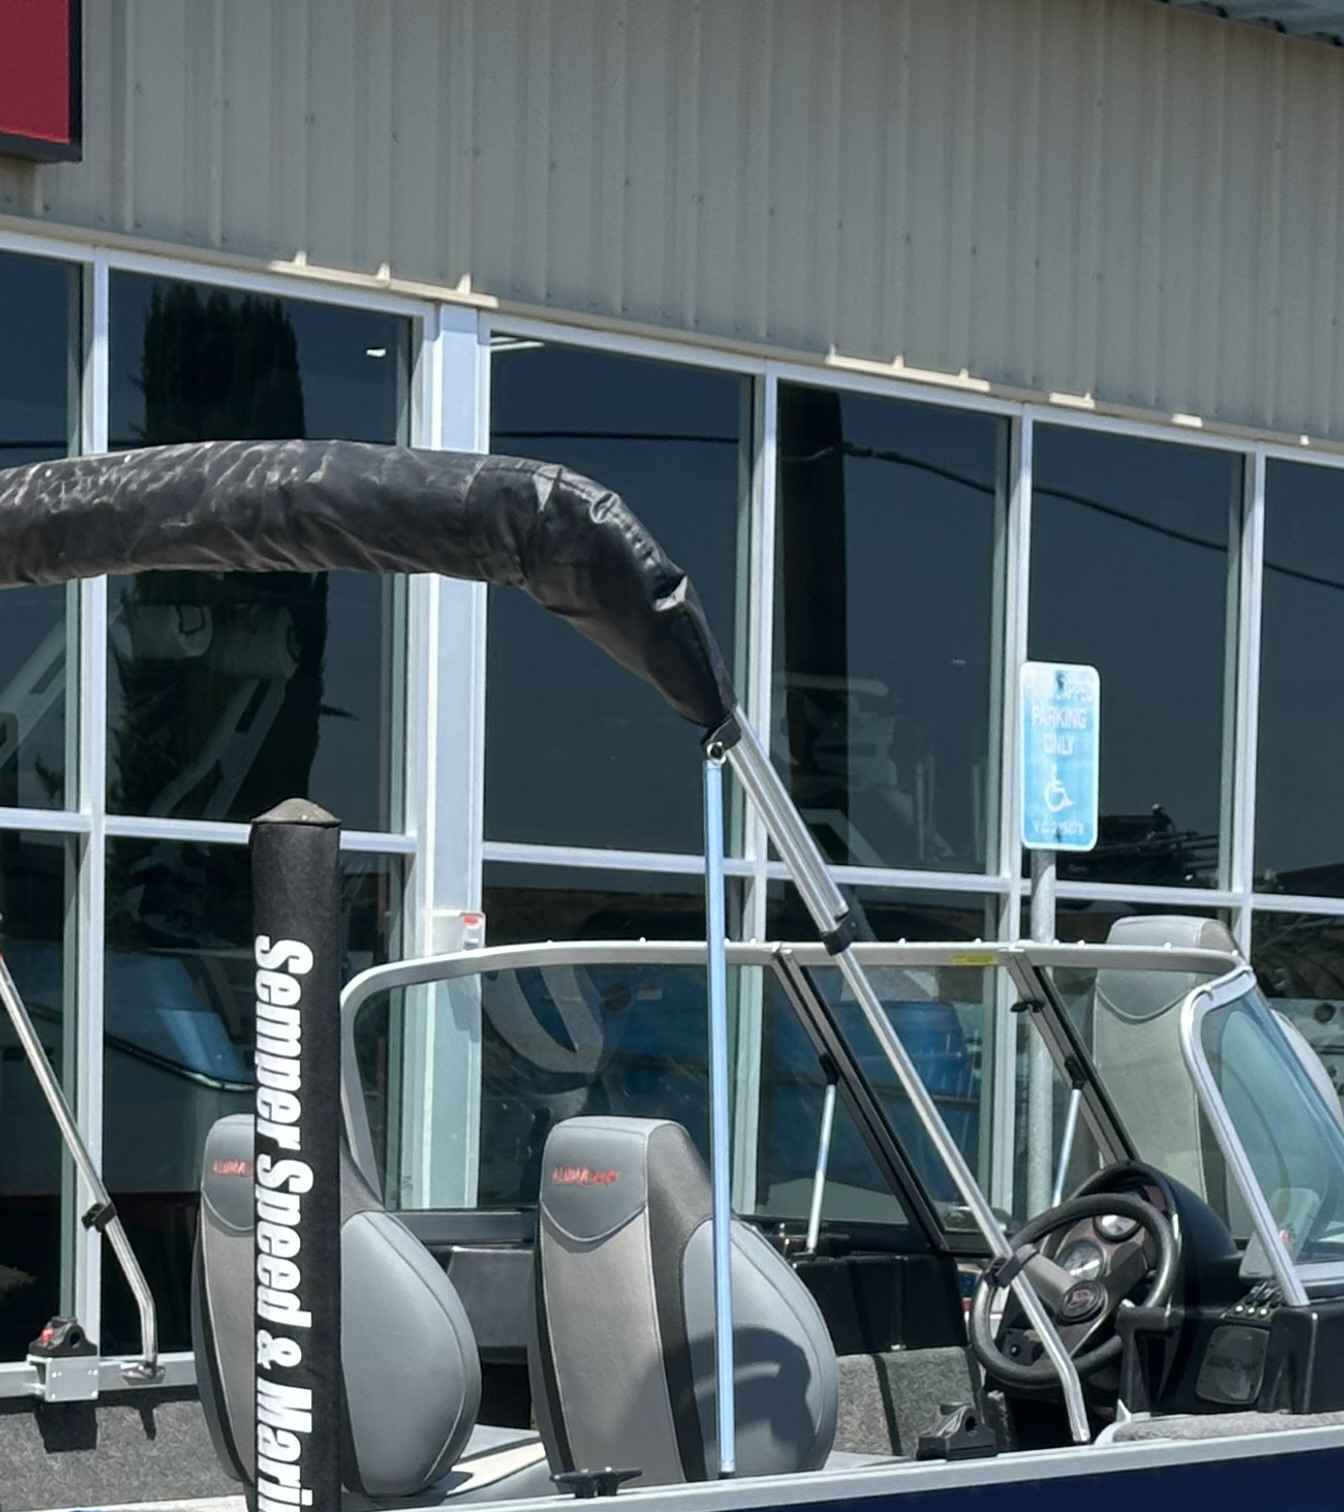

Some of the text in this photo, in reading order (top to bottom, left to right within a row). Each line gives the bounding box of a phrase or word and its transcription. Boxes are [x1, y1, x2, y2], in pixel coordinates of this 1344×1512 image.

[1031, 703, 1089, 729] PARKING
[255, 934, 314, 1150] Semper
[255, 1153, 314, 1328] Speed
[256, 1329, 302, 1370] &
